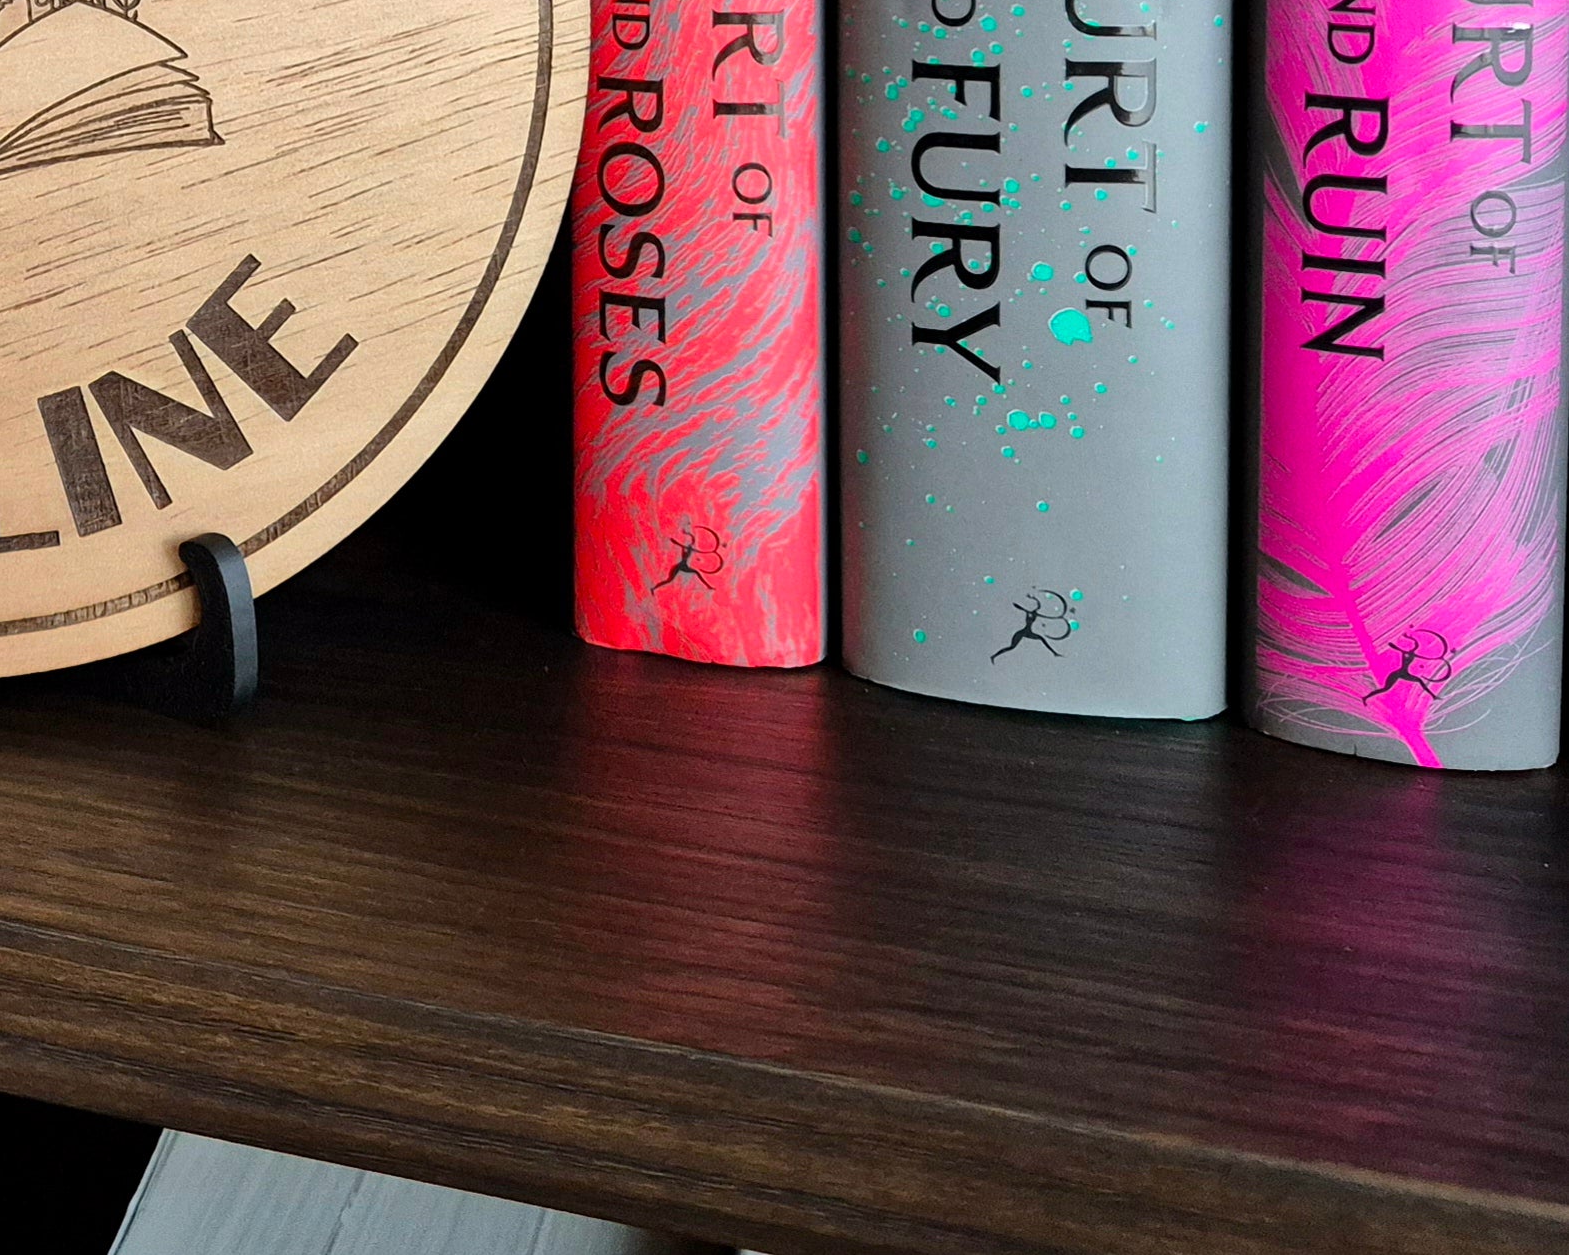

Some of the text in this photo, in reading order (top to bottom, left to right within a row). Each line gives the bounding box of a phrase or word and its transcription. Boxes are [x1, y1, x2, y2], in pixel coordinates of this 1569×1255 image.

[596, 75, 667, 407] ROSES
[732, 162, 773, 237] OF
[911, 59, 1001, 385] FURY
[1083, 243, 1132, 329] OF
[1300, 91, 1389, 362] RUIN
[1469, 190, 1517, 274] OF
